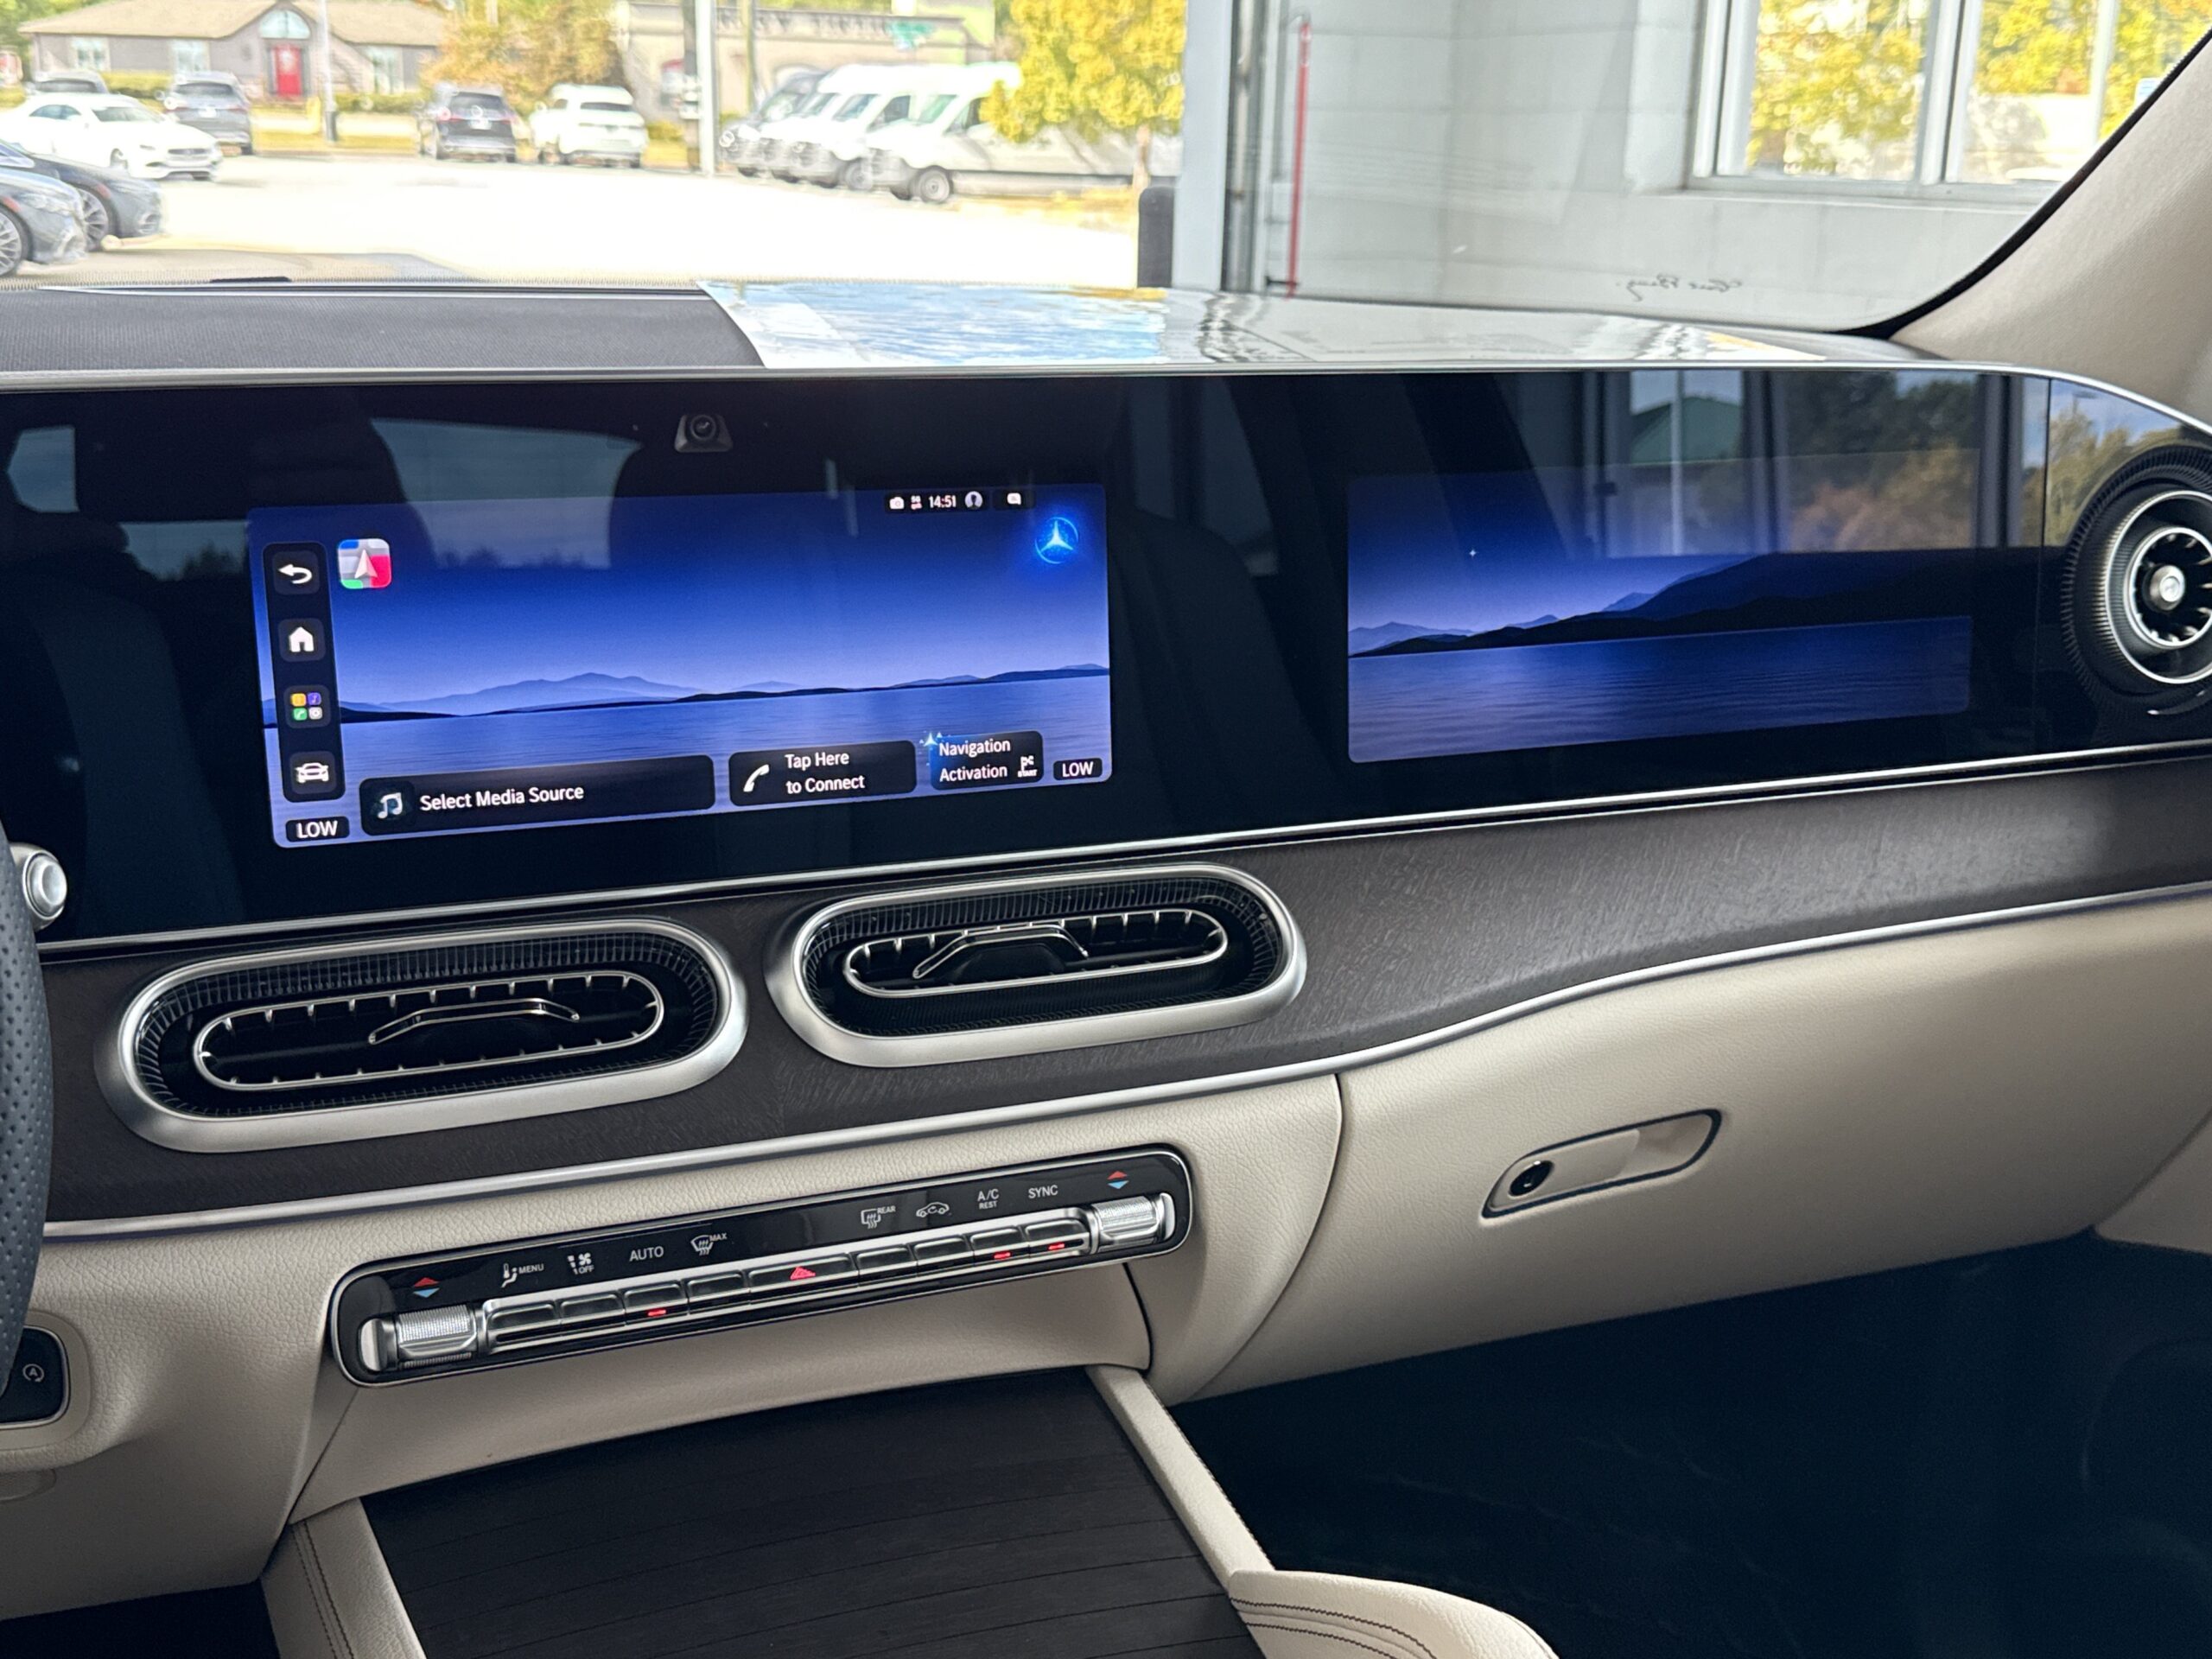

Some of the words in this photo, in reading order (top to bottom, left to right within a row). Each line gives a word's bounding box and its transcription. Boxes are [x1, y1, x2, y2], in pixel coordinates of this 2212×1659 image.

[929, 495, 957, 508] 14:51
[939, 739, 1011, 757] Navigation
[785, 753, 811, 772] Tap
[815, 752, 849, 767] Here
[939, 765, 1007, 782] Activation
[1062, 761, 1094, 778] LOW
[785, 780, 802, 795] to
[805, 775, 866, 793] Connect
[420, 793, 473, 811] Select
[476, 788, 525, 807] Media
[529, 786, 585, 803] Source
[296, 820, 338, 839] LOW
[977, 1189, 1000, 1201] A/C
[1028, 1185, 1058, 1198] SYNC
[878, 1205, 896, 1215] REAR
[978, 1200, 999, 1210] REST
[709, 1232, 728, 1242] MAX
[629, 1246, 664, 1262] AUTO
[518, 1263, 544, 1274] MENU
[579, 1265, 594, 1274] OFF
